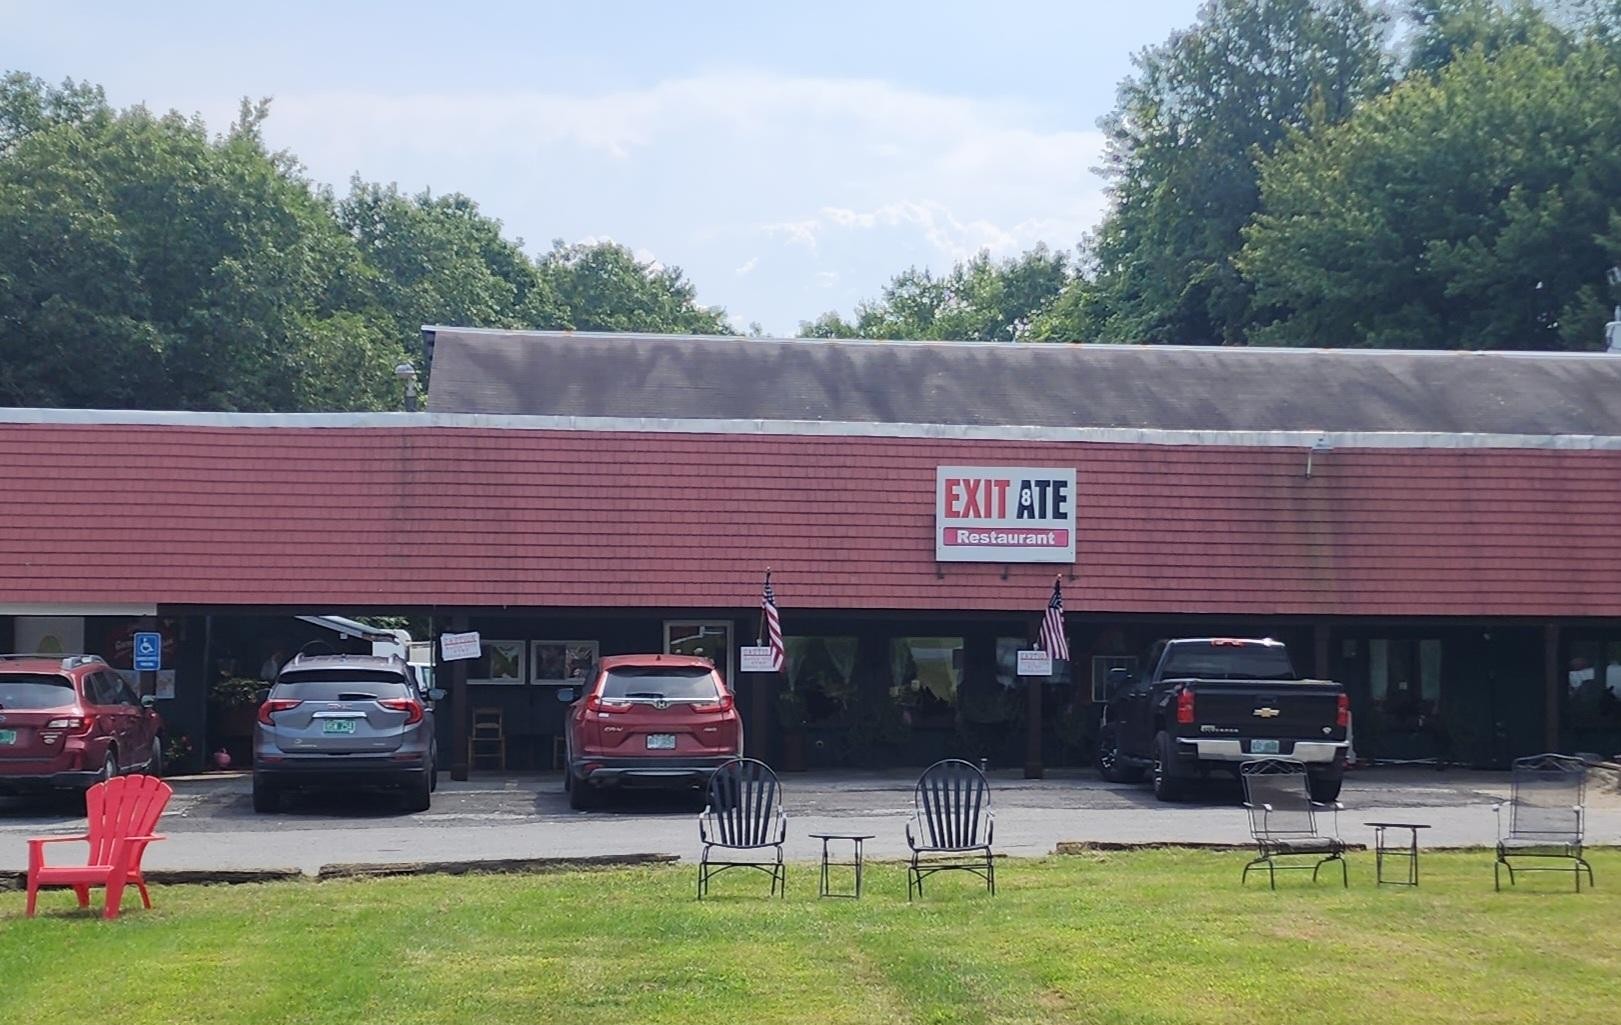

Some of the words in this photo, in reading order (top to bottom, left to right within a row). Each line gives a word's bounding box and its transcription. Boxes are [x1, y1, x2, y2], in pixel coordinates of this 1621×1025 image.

[944, 478, 1010, 519] EXIT
[1016, 479, 1068, 520] ATE
[1021, 488, 1031, 506] 8
[957, 529, 1055, 545] Restaurant
